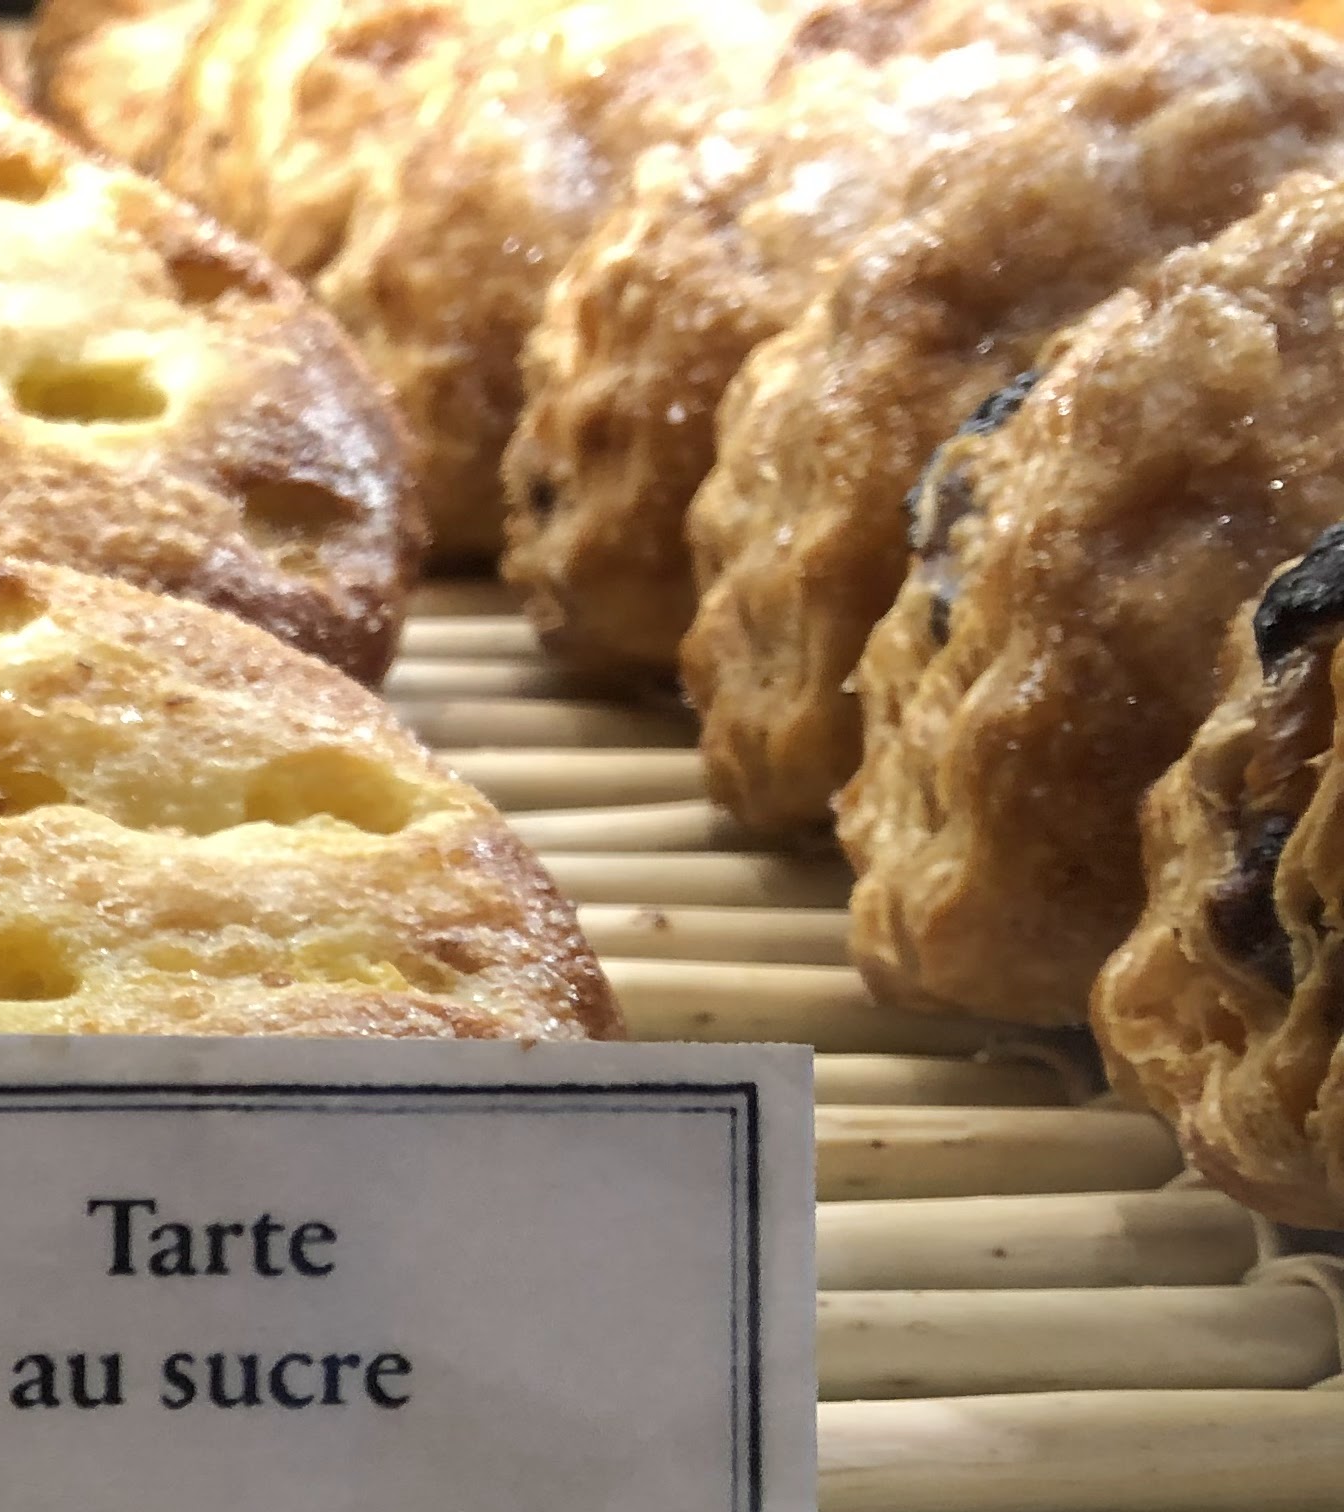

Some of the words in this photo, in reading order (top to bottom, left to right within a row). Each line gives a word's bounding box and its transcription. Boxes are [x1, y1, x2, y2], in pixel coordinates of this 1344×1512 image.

[86, 1198, 338, 1278] Tarte
[9, 1352, 125, 1410] au
[161, 1352, 414, 1410] sucre
